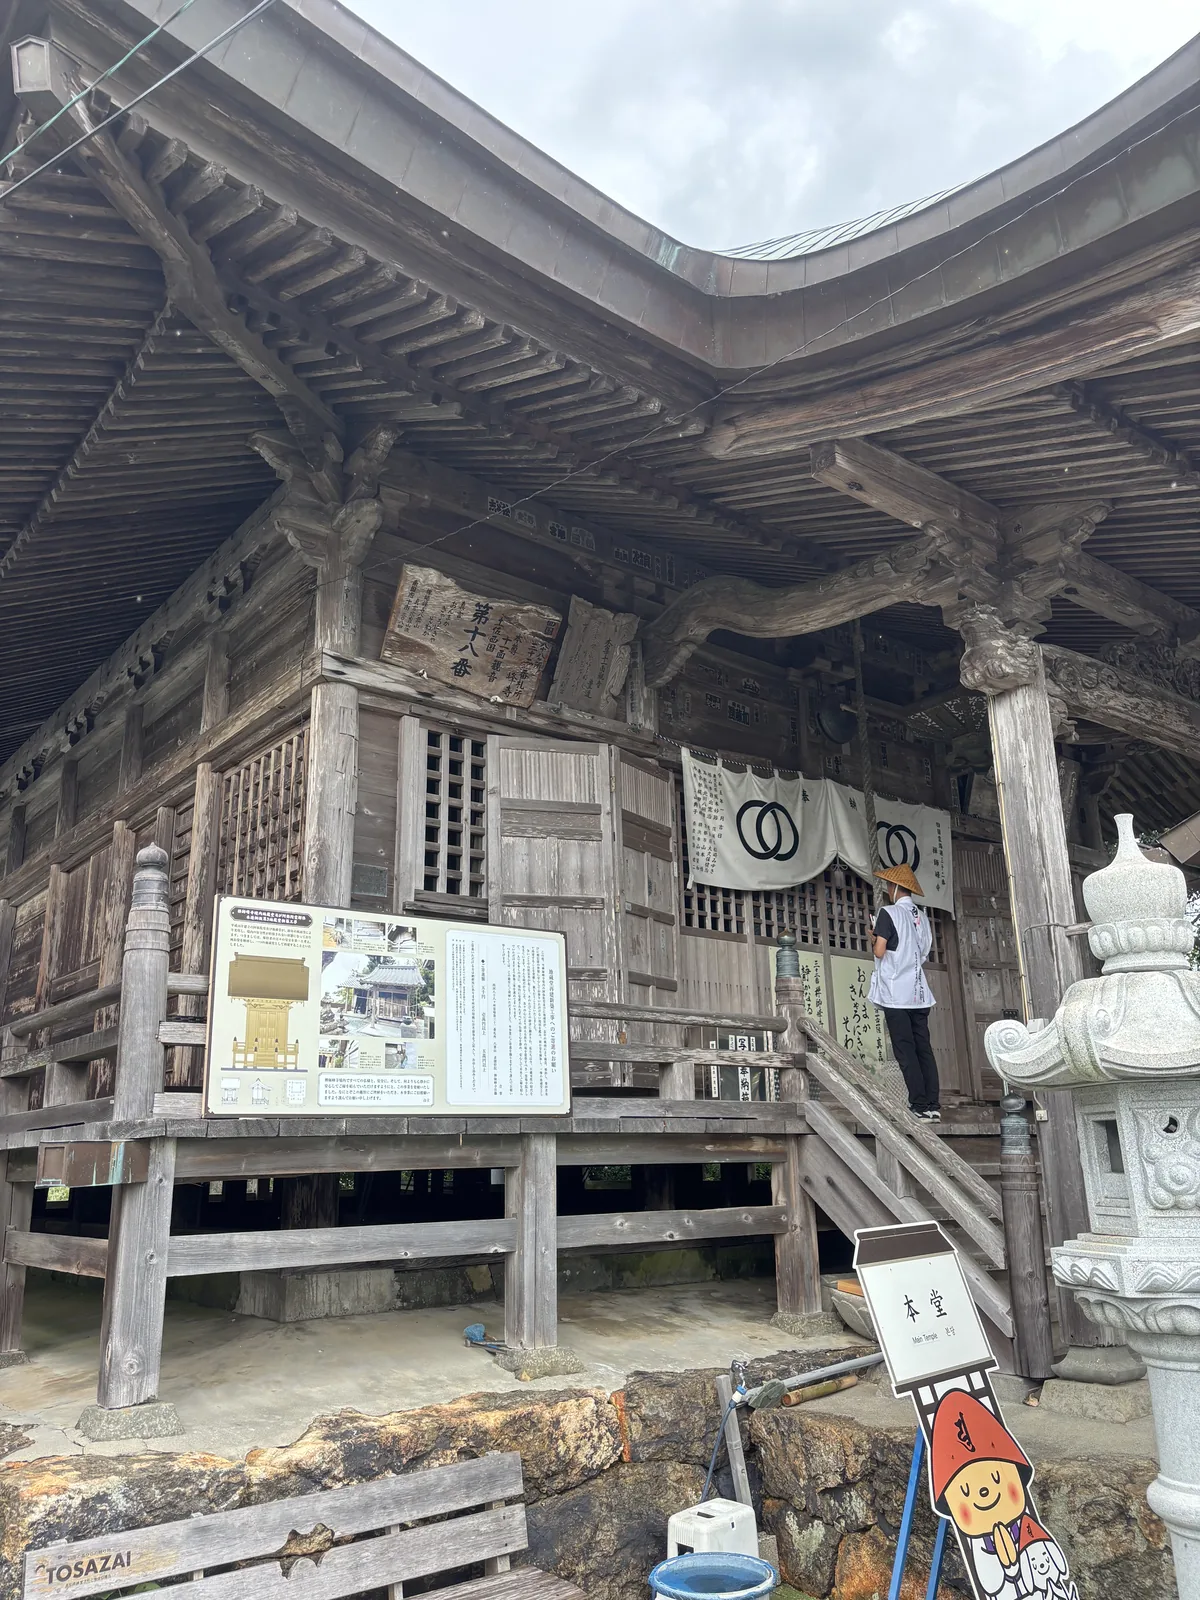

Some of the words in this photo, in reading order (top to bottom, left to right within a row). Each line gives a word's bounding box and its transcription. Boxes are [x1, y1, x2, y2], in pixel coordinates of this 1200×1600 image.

[450, 600, 494, 679] 第十八番
[857, 966, 871, 1033] おんまか
[903, 1289, 948, 1323] 本堂
[911, 1335, 923, 1344] Main
[923, 1333, 939, 1342] Temple
[45, 1550, 132, 1585] TOSAZAI
